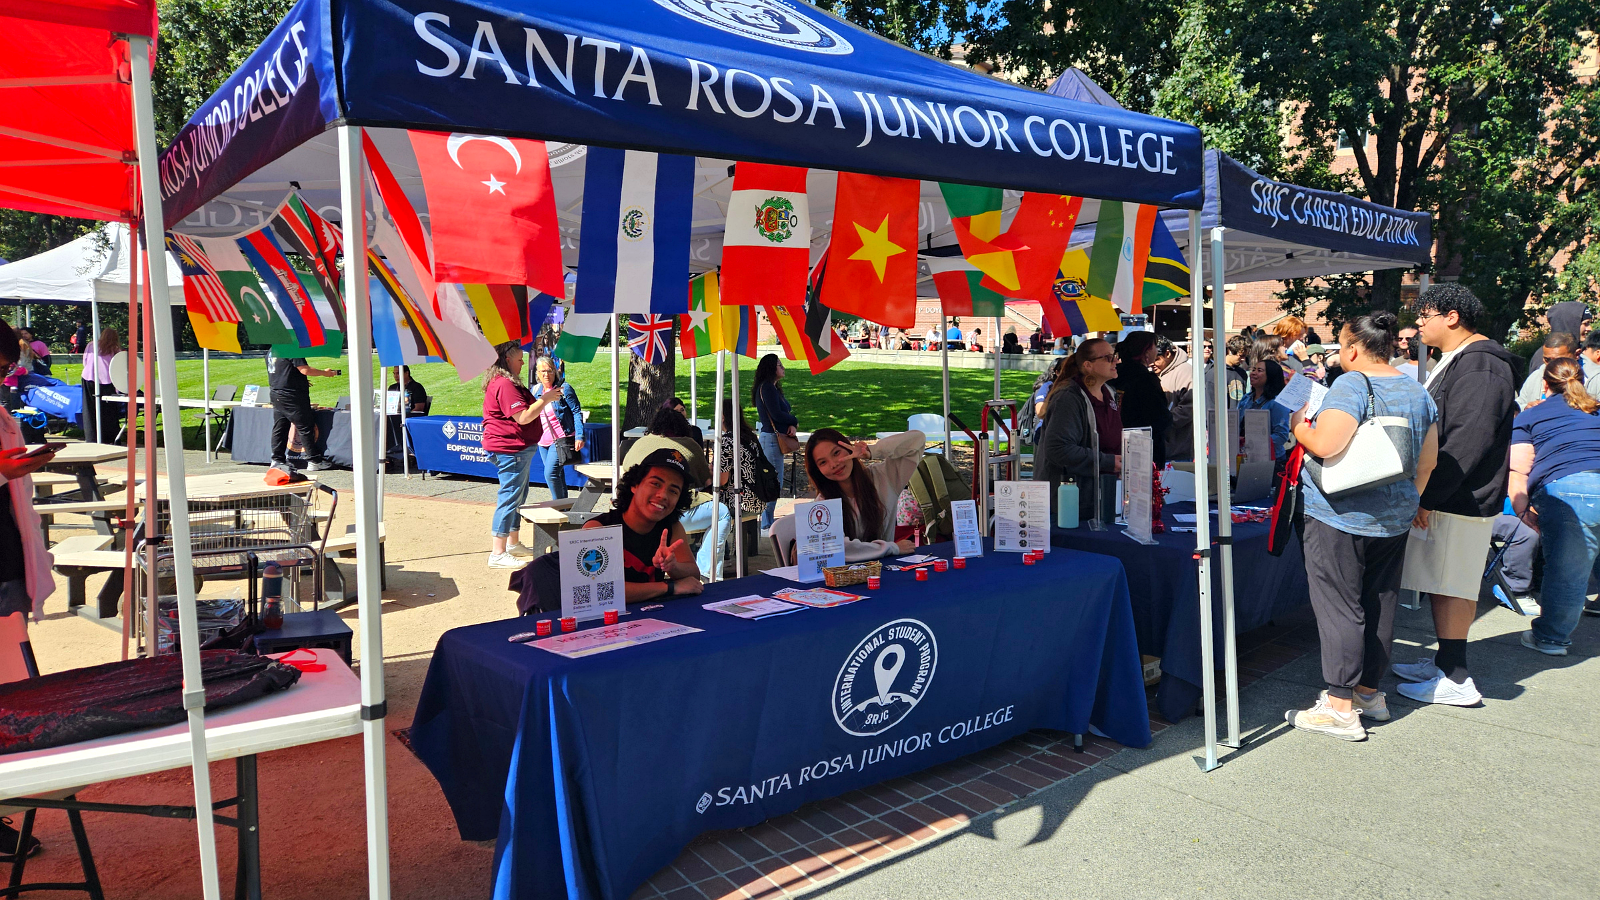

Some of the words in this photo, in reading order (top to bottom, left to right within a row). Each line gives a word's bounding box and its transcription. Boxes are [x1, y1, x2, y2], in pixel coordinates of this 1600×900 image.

[413, 11, 662, 106] SANTA
[685, 57, 846, 129] ROSA
[852, 90, 1020, 153] JUNIOR
[1024, 114, 1178, 175] COLLEGE
[160, 139, 191, 202] ROSA
[189, 99, 232, 189] JUNIOR
[1250, 179, 1290, 228] SRJC
[1290, 192, 1350, 234] CAREER
[1350, 206, 1420, 247] EDUCATION
[446, 444, 485, 455] EOPS/CAR
[458, 422, 484, 432] SANT
[460, 454, 476, 462] (707)
[840, 633, 886, 714] INTERNATIONAL
[888, 625, 926, 646] STUDENT
[910, 642, 931, 695] PROGRAM
[864, 709, 889, 725] SRJC
[715, 773, 793, 807] SANTA
[798, 753, 854, 786] ROSA
[858, 731, 931, 773] JUNIOR
[938, 704, 1015, 744] COLLEGE
